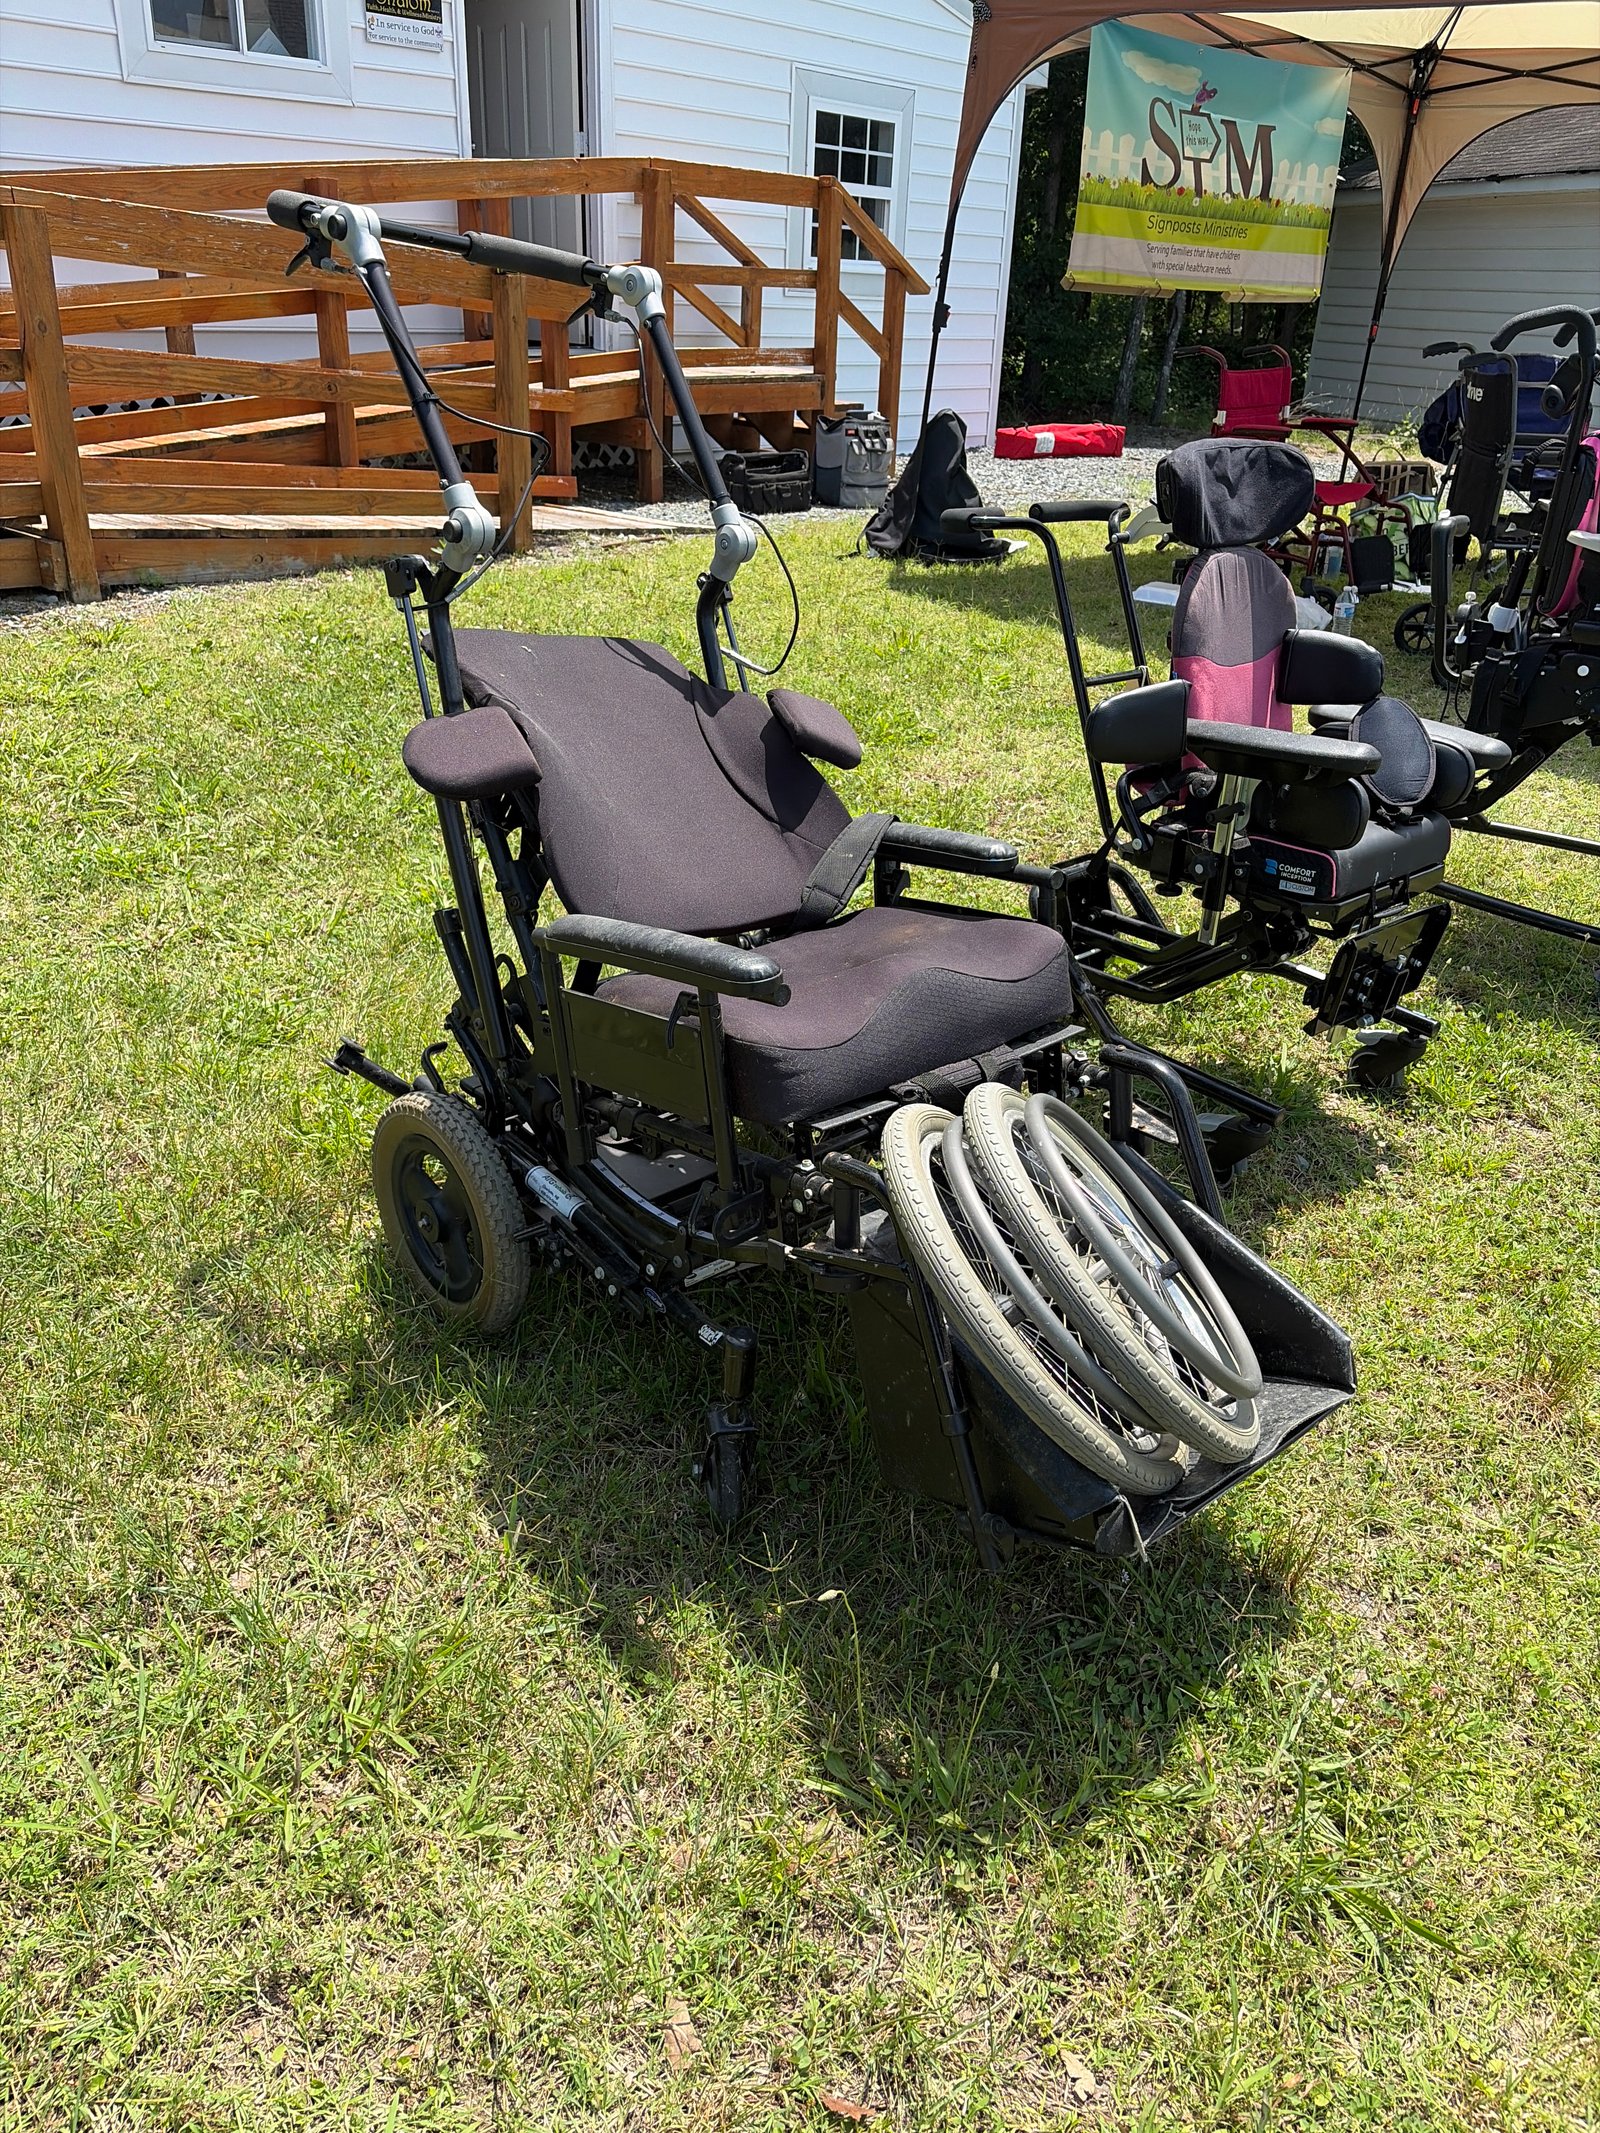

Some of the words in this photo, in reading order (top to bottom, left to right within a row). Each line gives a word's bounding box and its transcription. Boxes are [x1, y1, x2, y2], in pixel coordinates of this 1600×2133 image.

[376, 18, 385, 28] In
[386, 21, 411, 32] service
[413, 25, 420, 34] to
[421, 26, 435, 36] God
[379, 34, 397, 43] service
[404, 37, 413, 45] the
[414, 40, 443, 51] community
[1147, 215, 1201, 235] Signposts
[1203, 221, 1248, 239] Ministries
[1146, 243, 1170, 257] Serving
[1170, 245, 1193, 257] families
[1194, 248, 1206, 258] that
[1206, 249, 1220, 260] have
[1219, 250, 1241, 261] children
[1152, 261, 1166, 269] with
[1166, 261, 1186, 272] special
[1185, 262, 1215, 274] healthcare
[1215, 265, 1232, 275] needs.
[1279, 863, 1317, 878] COMFORT
[1280, 871, 1312, 883] INCEPTION
[1292, 884, 1314, 892] CUSTOM
